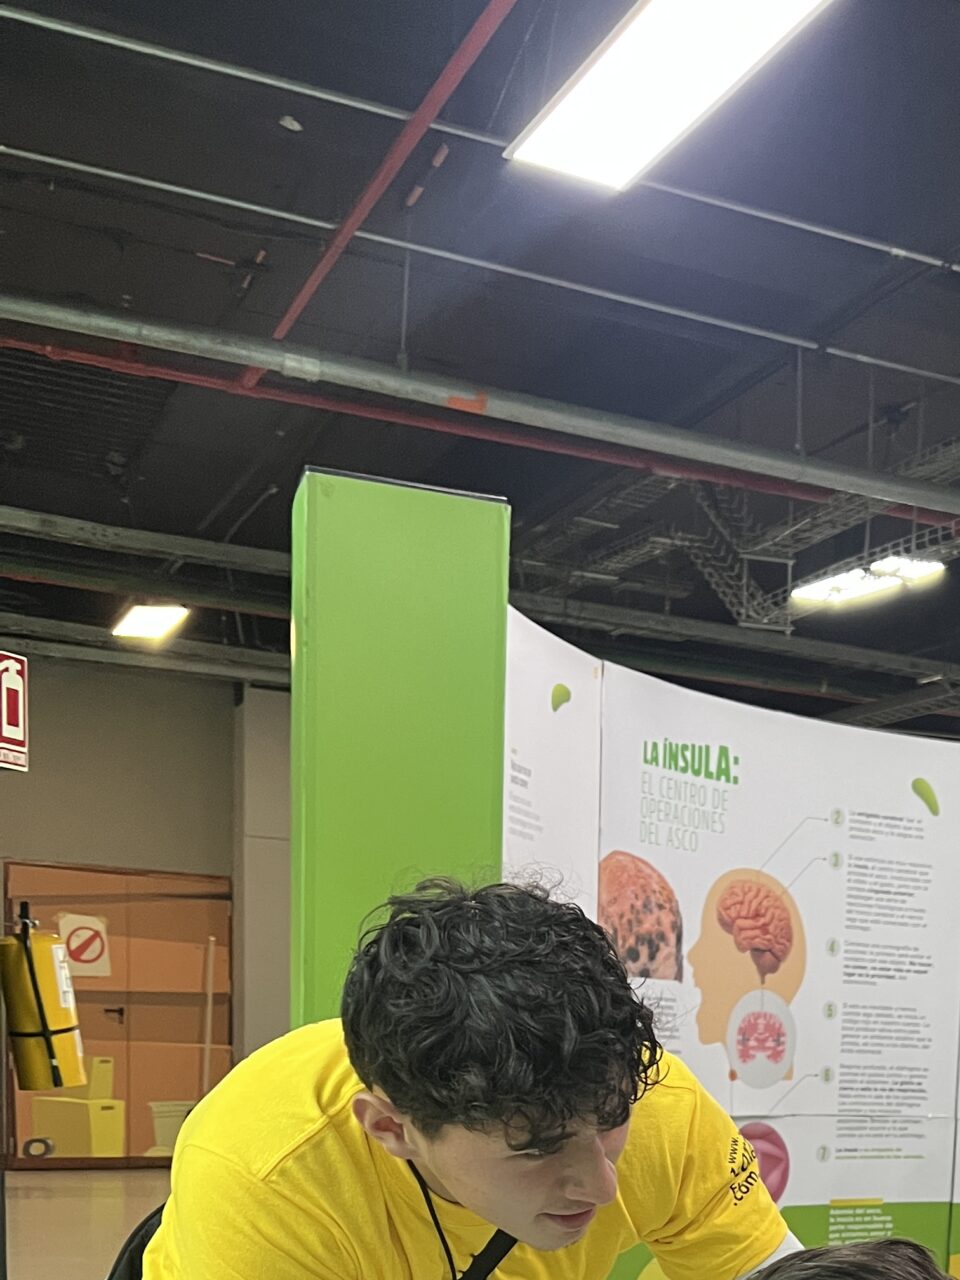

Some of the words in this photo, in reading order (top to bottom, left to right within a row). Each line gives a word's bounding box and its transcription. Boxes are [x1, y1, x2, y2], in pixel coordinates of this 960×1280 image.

[643, 740, 659, 767] LA
[663, 737, 739, 785] ÍNSULA:
[641, 771, 654, 796] EL
[660, 776, 706, 807] CENTRO
[712, 788, 728, 811] DE
[641, 796, 725, 834] OPERACIONES
[640, 820, 661, 846] DEL
[666, 826, 698, 852] ASCO
